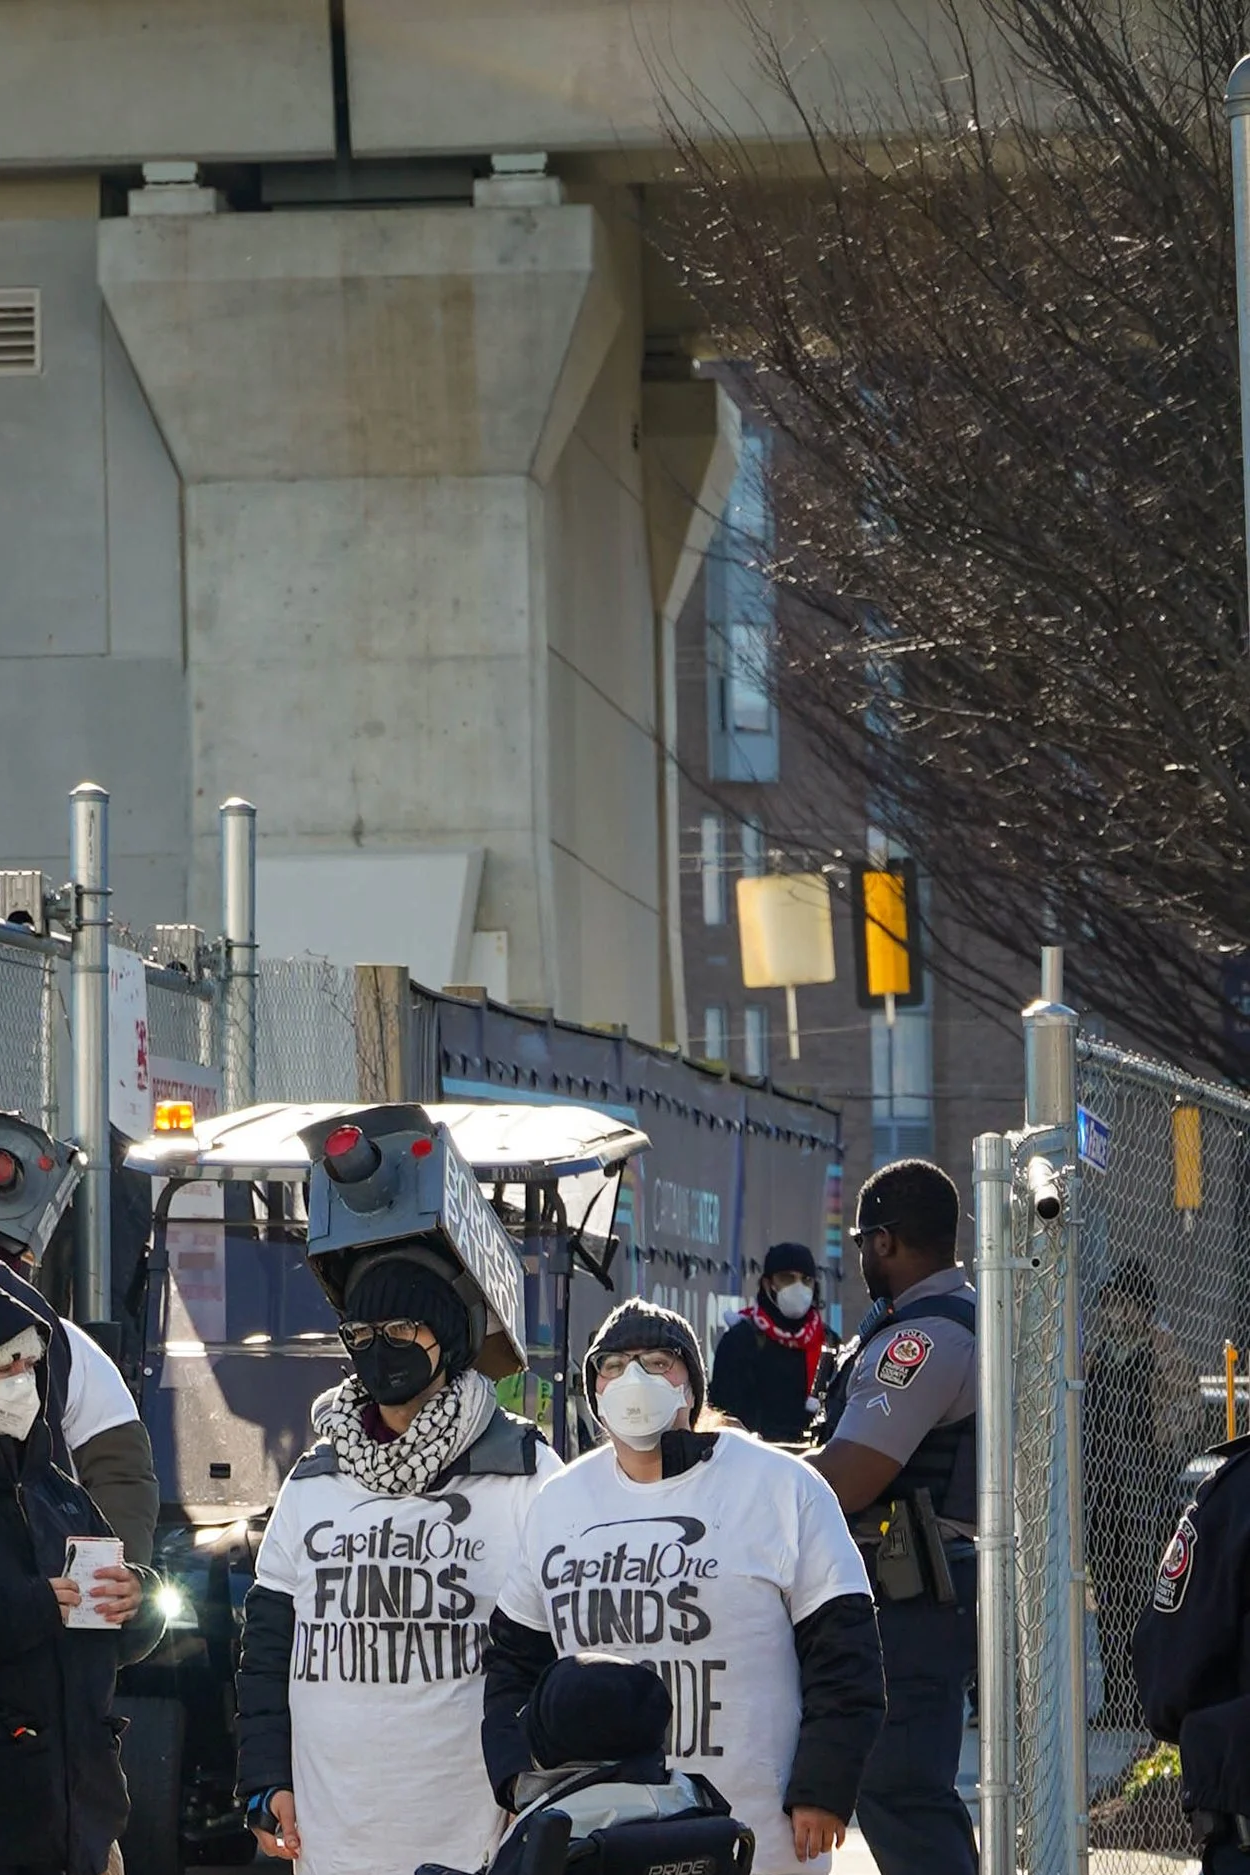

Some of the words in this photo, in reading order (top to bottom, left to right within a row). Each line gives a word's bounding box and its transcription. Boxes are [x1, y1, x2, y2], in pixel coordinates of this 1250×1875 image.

[444, 1188, 526, 1360] PATROL
[445, 1145, 518, 1307] BORDER
[314, 1563, 477, 1622] FUND$
[551, 1581, 712, 1651] FUND$
